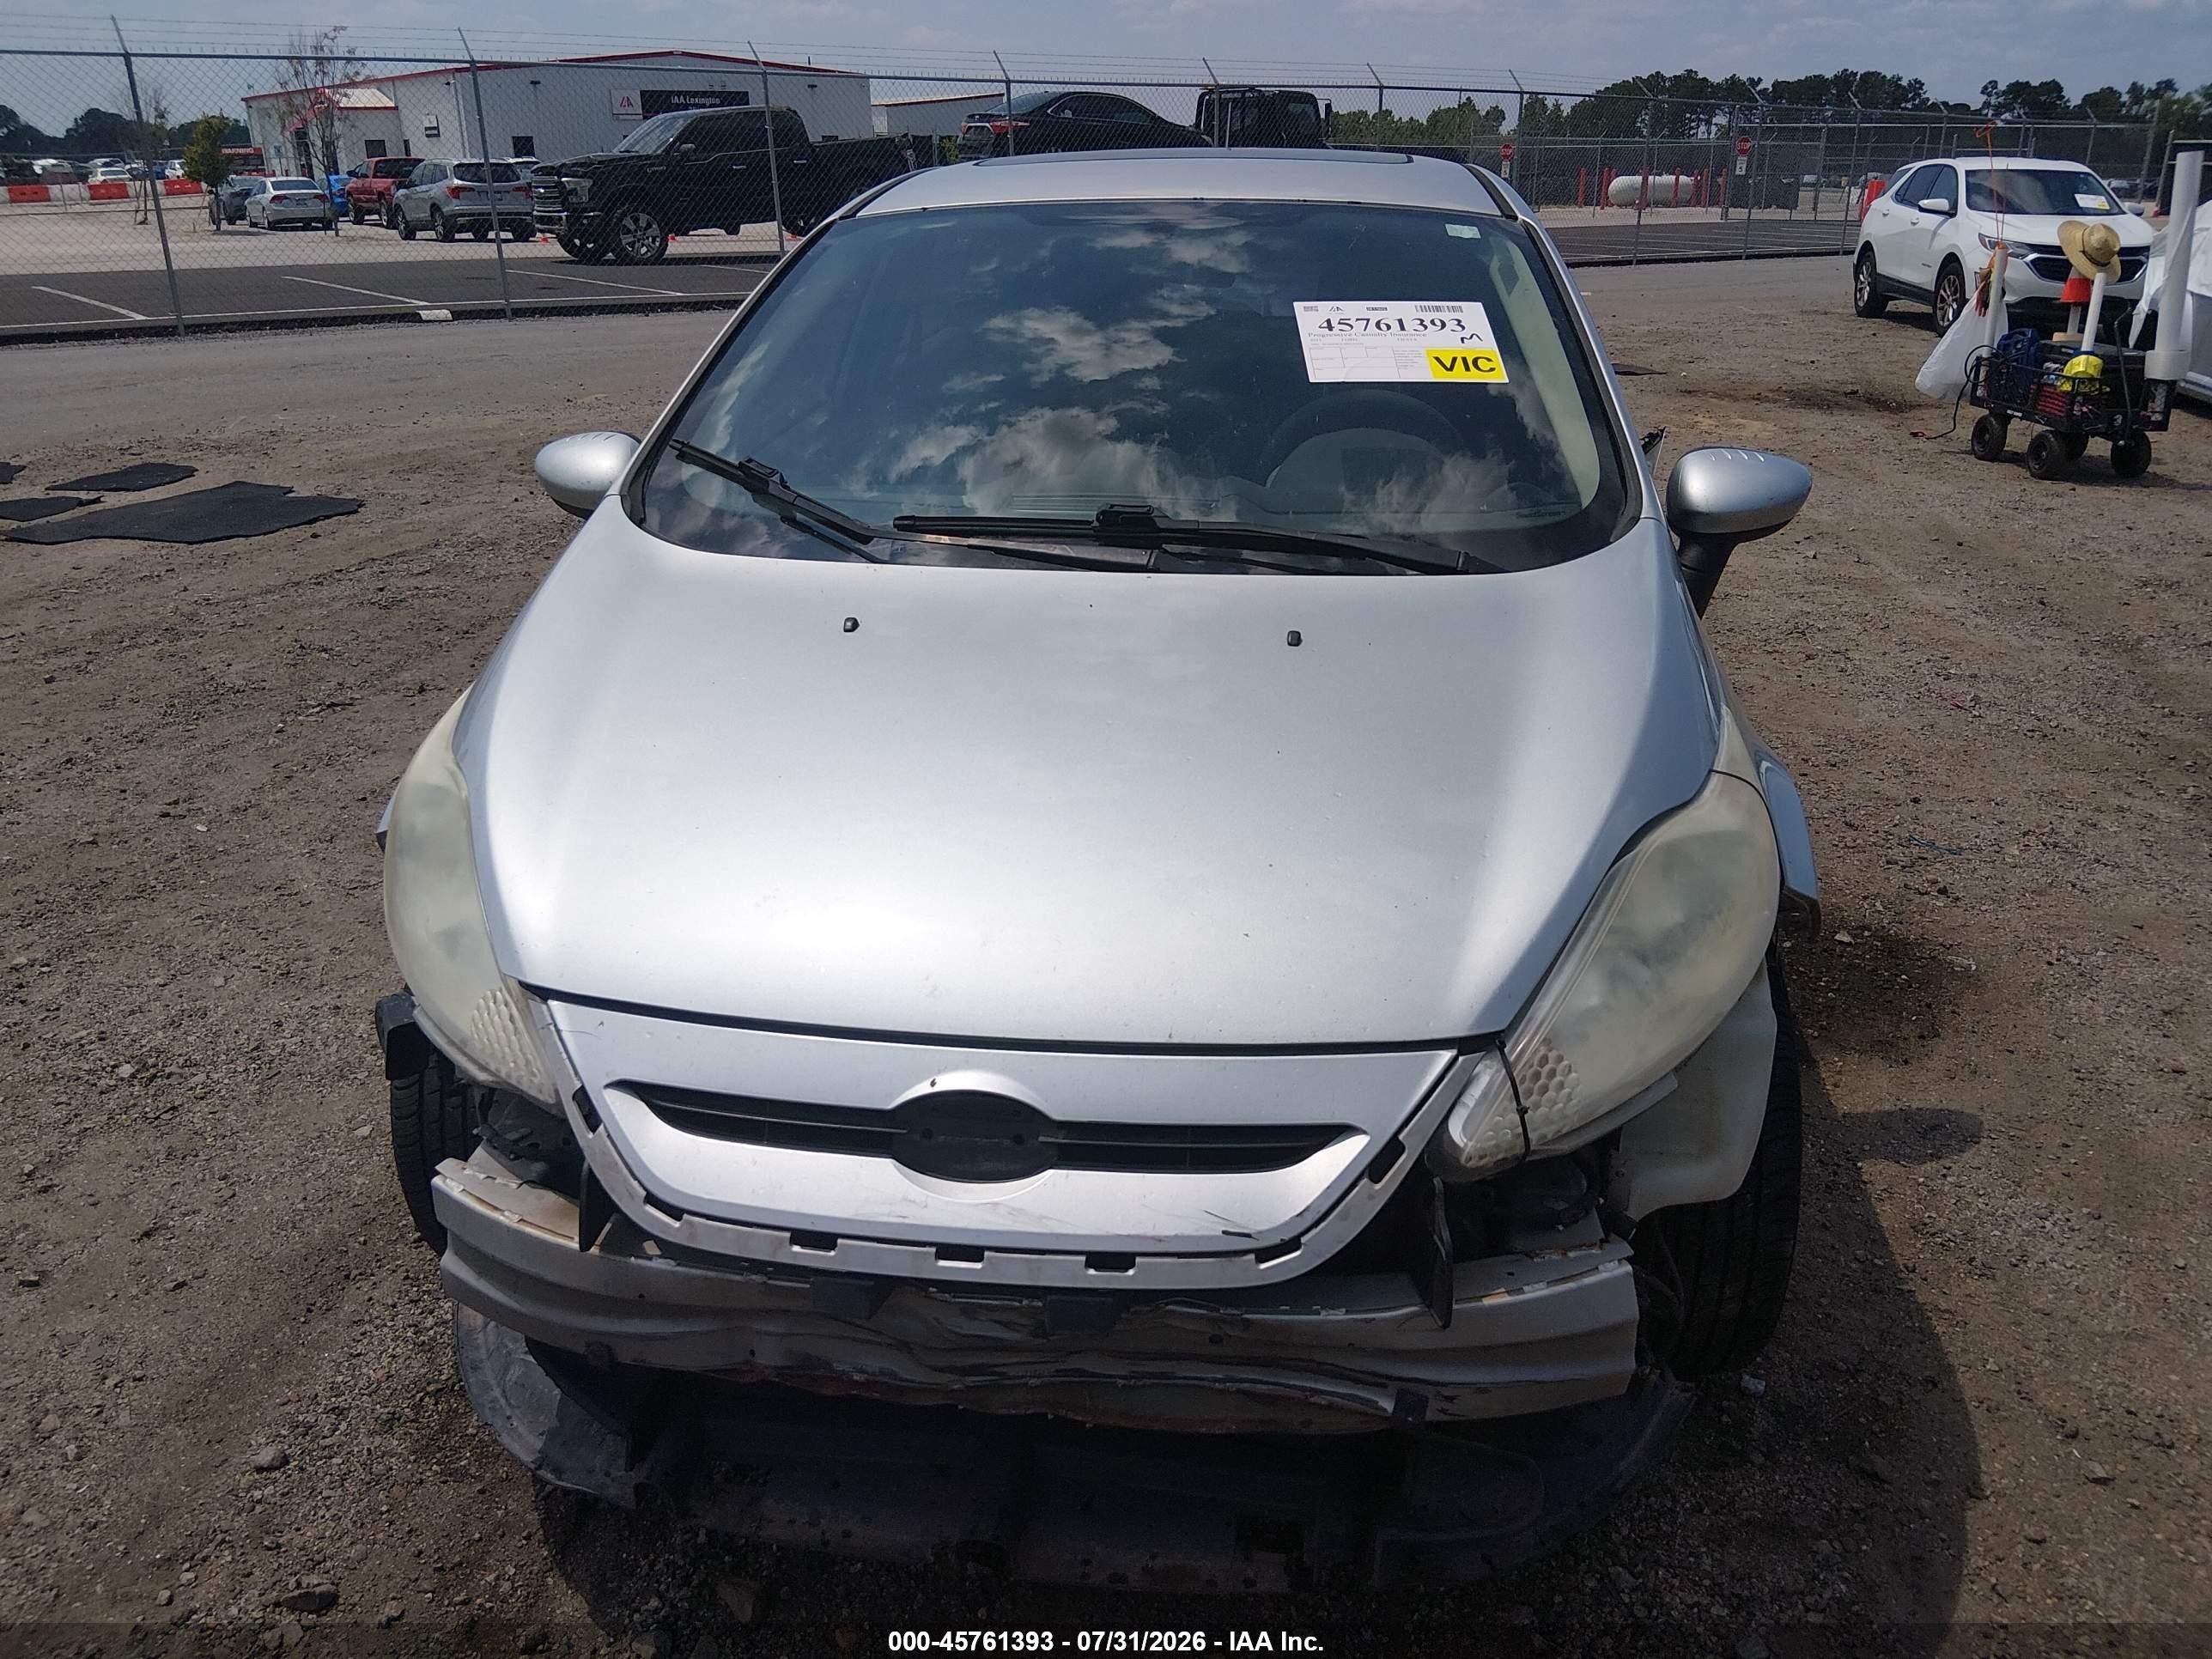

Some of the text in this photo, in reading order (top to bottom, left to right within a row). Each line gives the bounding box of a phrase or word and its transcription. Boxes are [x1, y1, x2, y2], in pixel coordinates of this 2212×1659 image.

[1737, 142, 1751, 150] STOP
[1318, 318, 1466, 332] 45761393
[1432, 356, 1496, 374] VIC
